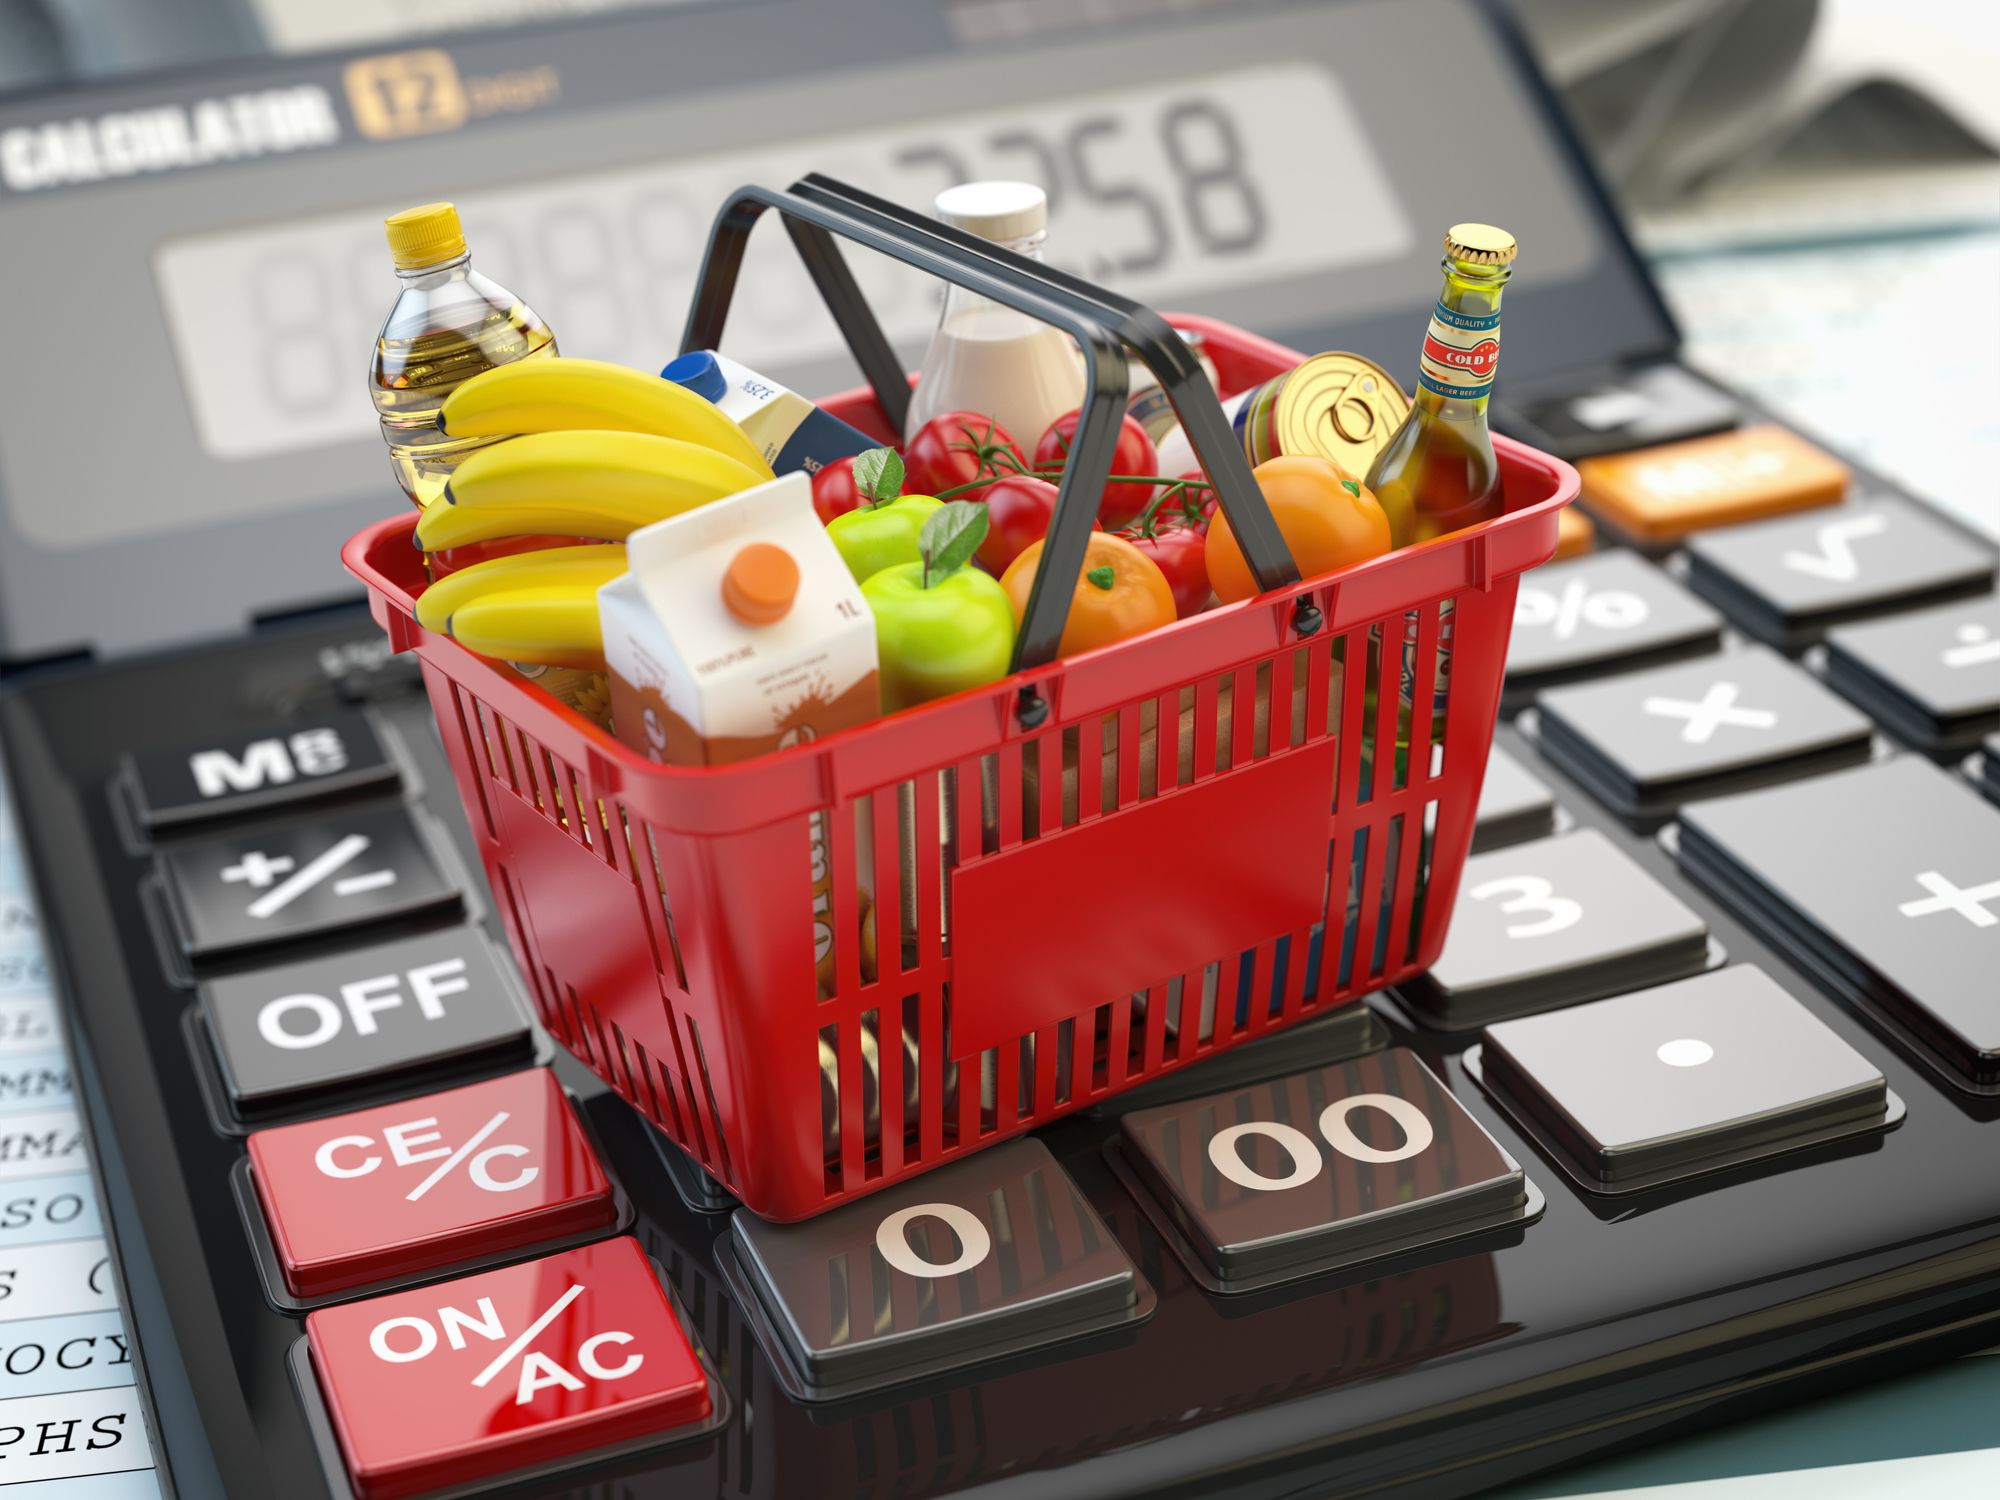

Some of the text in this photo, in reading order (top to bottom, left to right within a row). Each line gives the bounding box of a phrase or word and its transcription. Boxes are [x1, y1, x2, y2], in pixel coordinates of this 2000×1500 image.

[1455, 318, 1485, 328] QUALITY
[1446, 352, 1484, 366] COLD
[1468, 875, 1583, 939] 3
[257, 958, 469, 1049] OFF
[315, 1112, 539, 1202] CE/C
[369, 1284, 644, 1404] ON/AC
[0, 1413, 127, 1460] PHS
